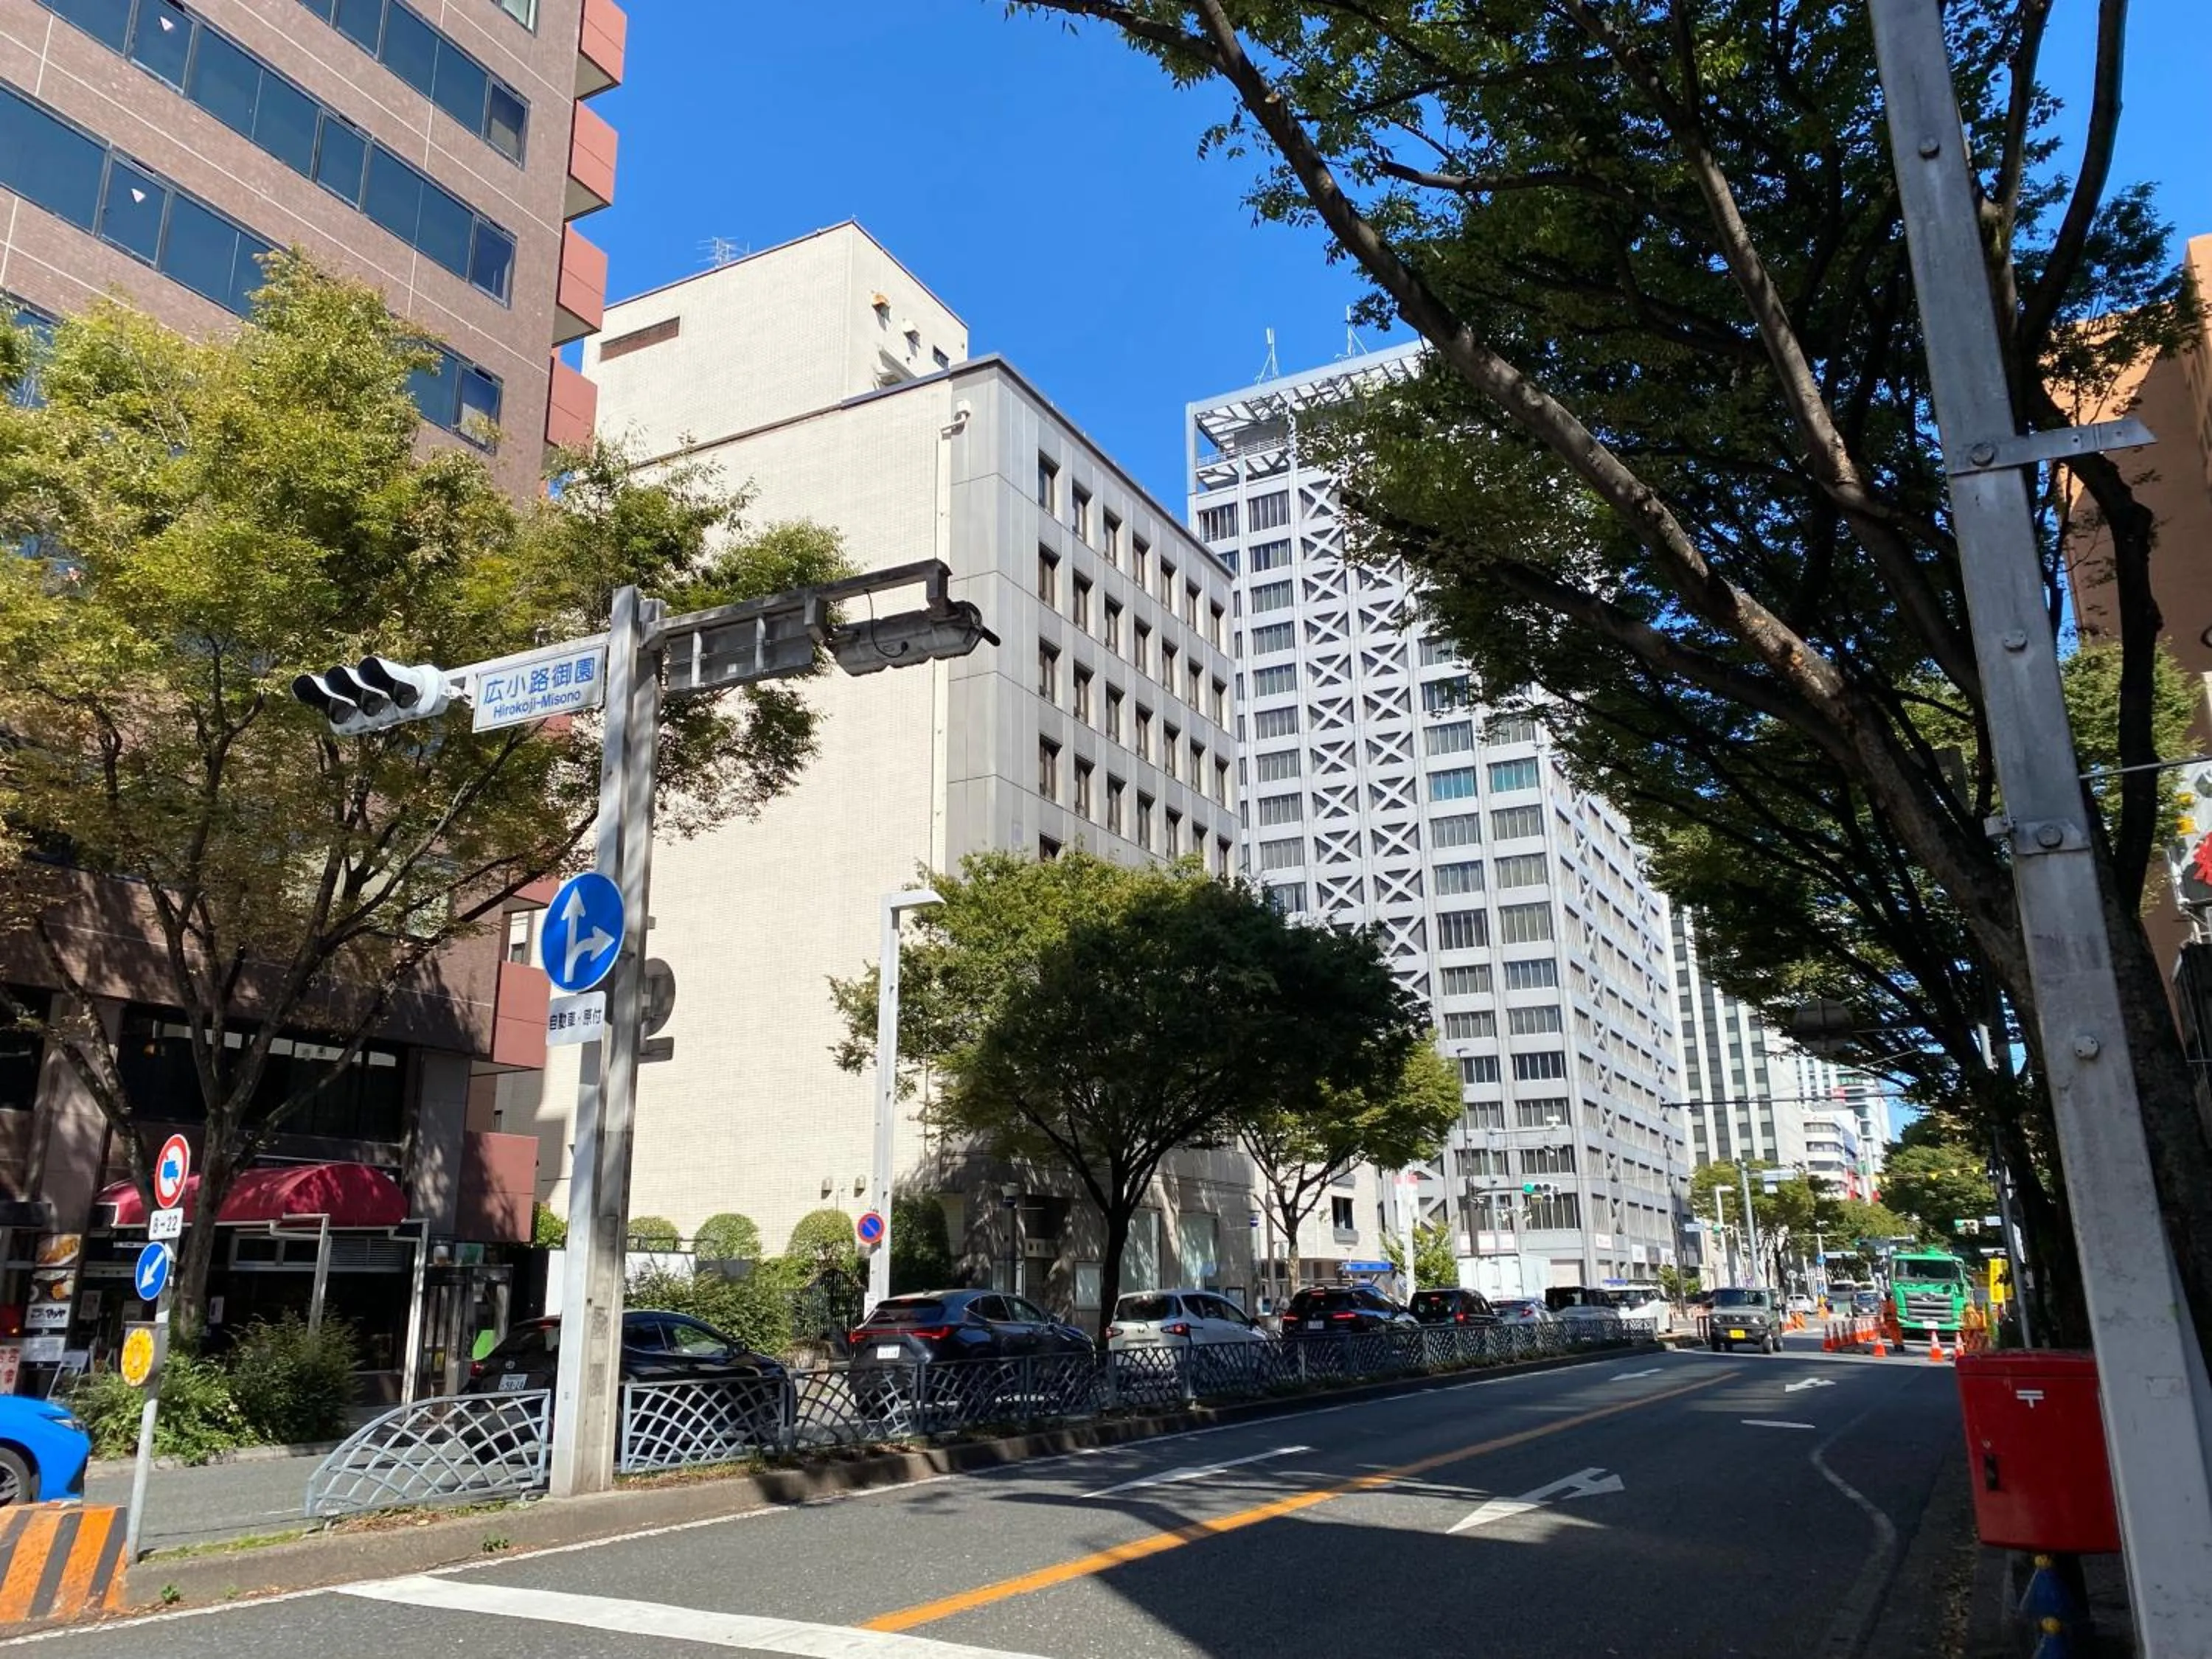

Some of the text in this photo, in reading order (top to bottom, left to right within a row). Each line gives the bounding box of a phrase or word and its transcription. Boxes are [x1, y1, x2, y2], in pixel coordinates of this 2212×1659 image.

[483, 657, 595, 704] 広小路御園
[493, 690, 581, 718] Hirokoji-Misono
